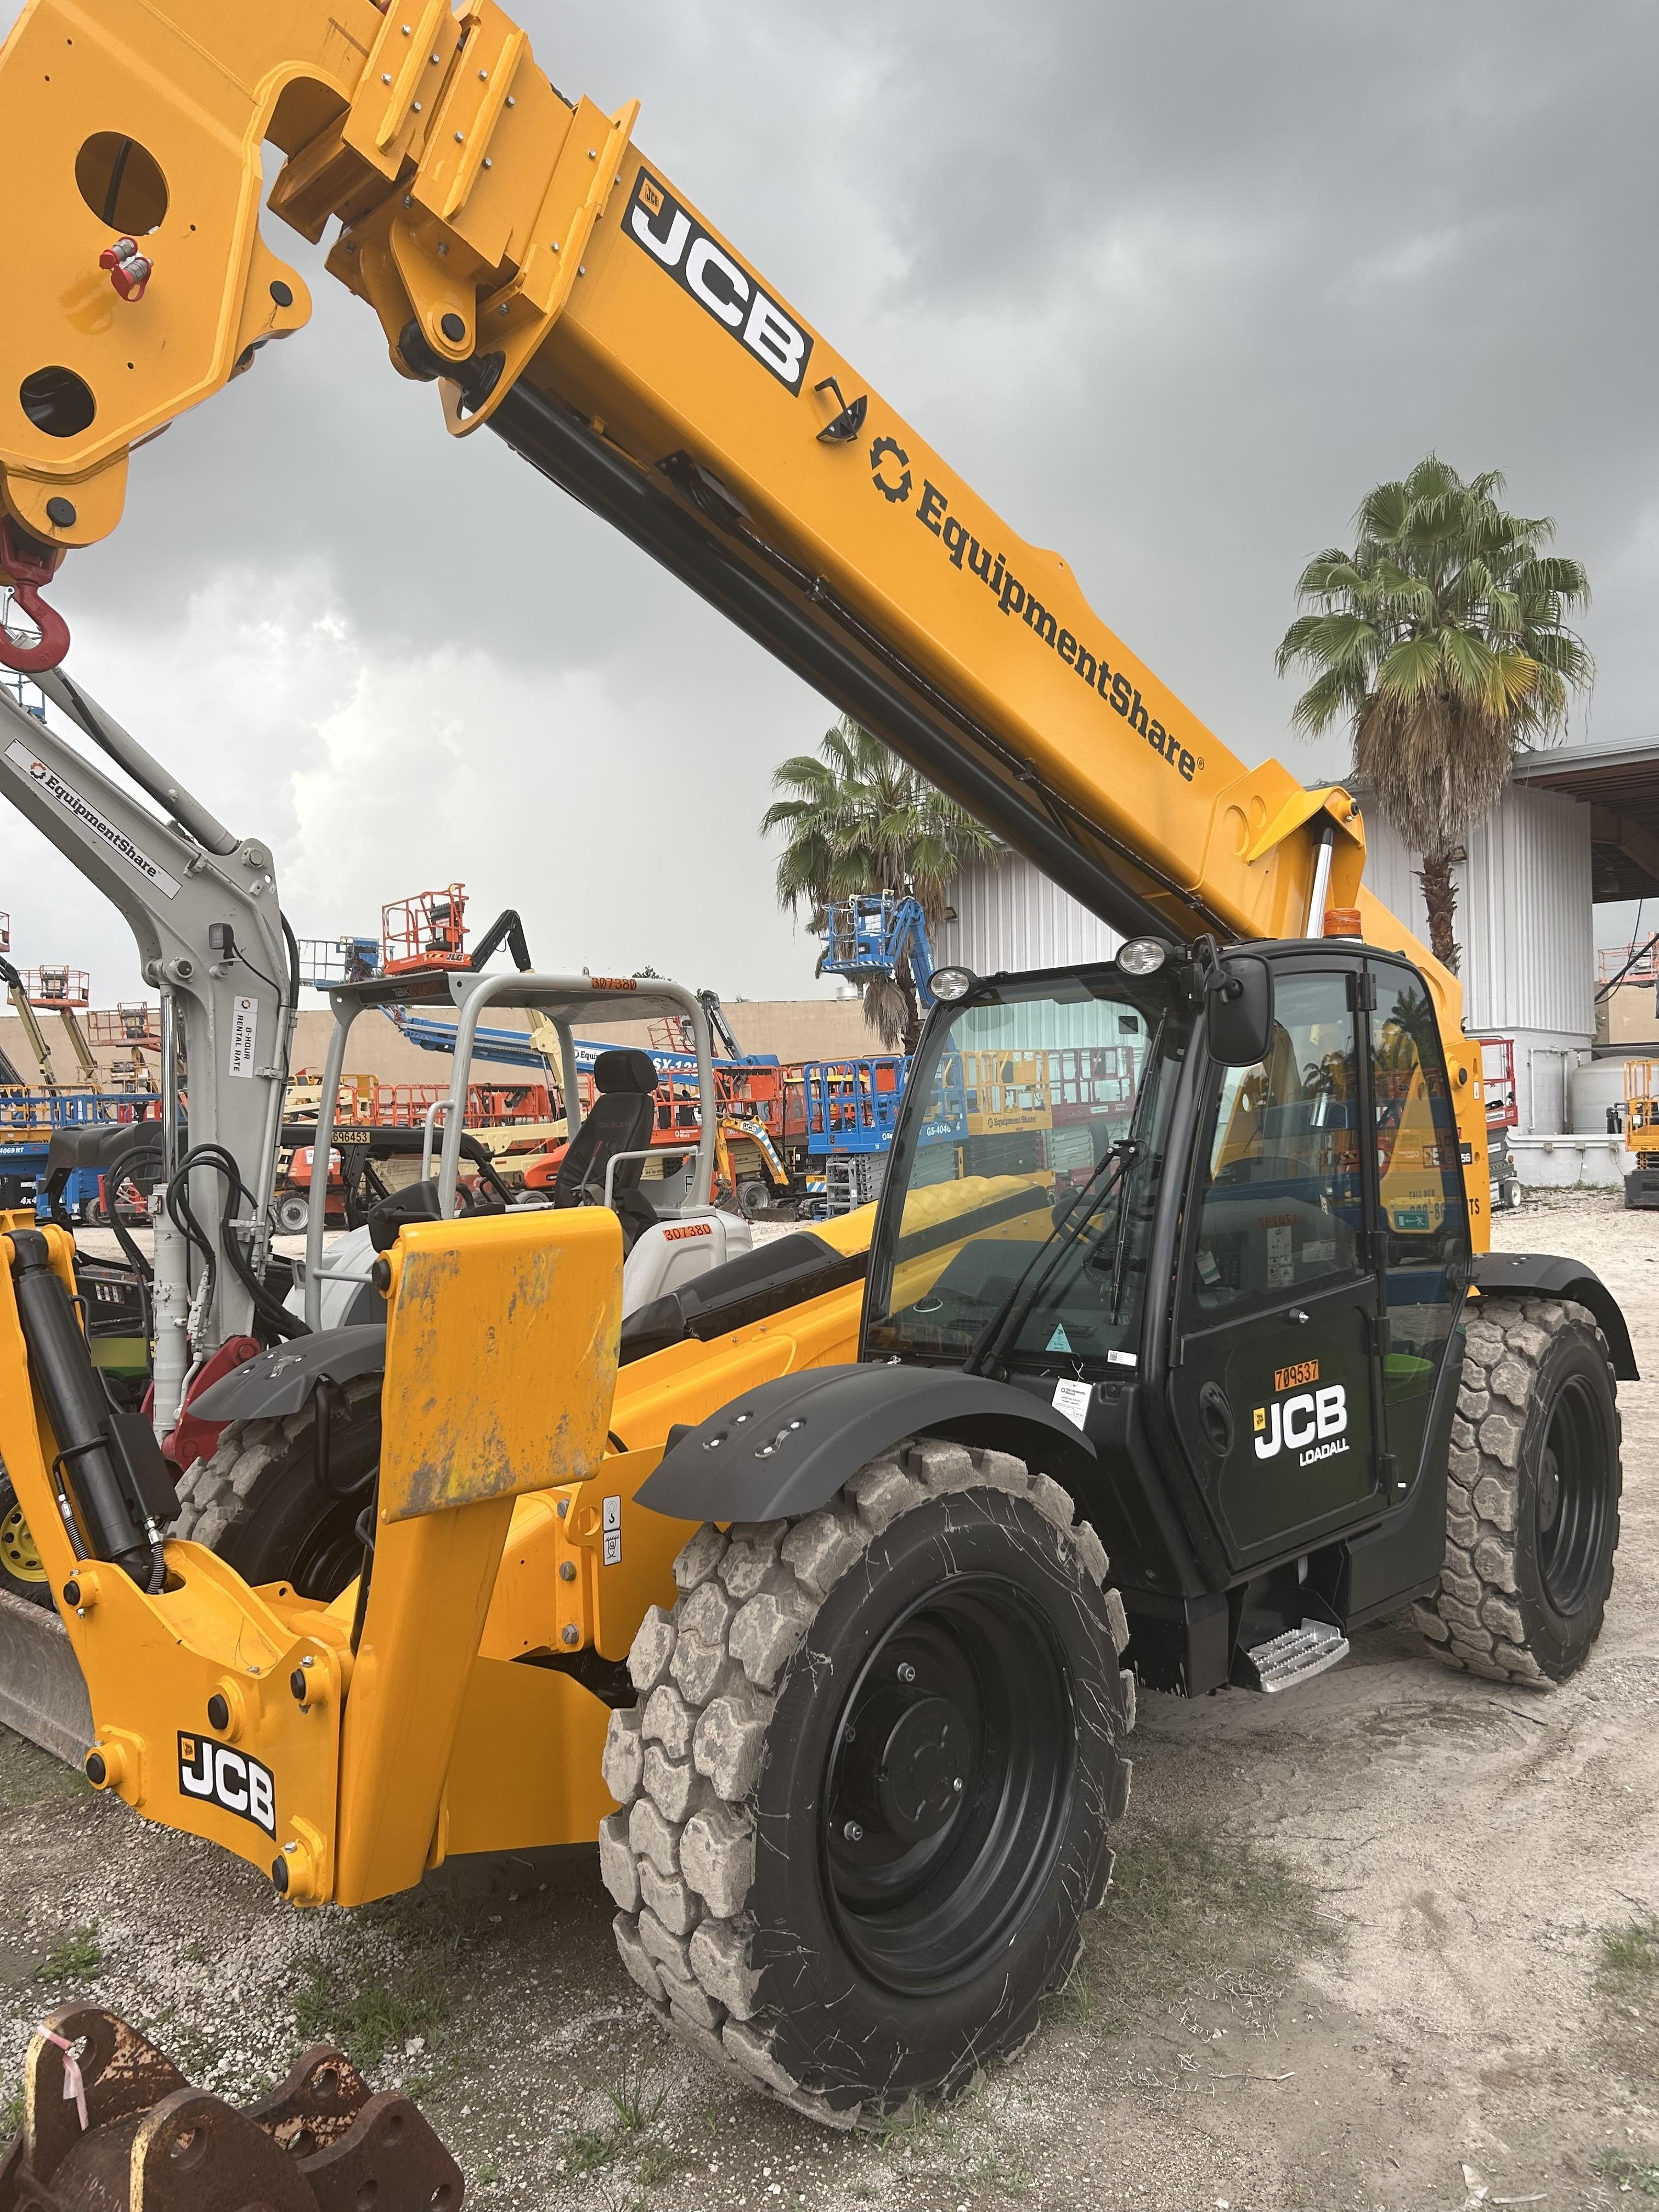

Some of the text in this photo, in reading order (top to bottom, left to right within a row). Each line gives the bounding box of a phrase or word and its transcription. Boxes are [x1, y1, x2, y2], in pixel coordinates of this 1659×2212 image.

[631, 204, 805, 383] JCB
[591, 977, 636, 990] 307380
[235, 1015, 244, 1047] RENTAL
[244, 1027, 252, 1059] 8-HOUR
[743, 1122, 757, 1133] JCB
[927, 1124, 951, 1136] GS-4046
[1022, 1115, 1036, 1124] Share
[332, 1132, 368, 1142] 696453
[20, 1197, 37, 1205] 4x4
[664, 1223, 711, 1242] 307380
[1276, 1361, 1318, 1391] 709537
[1254, 1384, 1347, 1460] JCB
[1299, 1437, 1350, 1468] LOADALL
[182, 1742, 274, 1831] JCB
